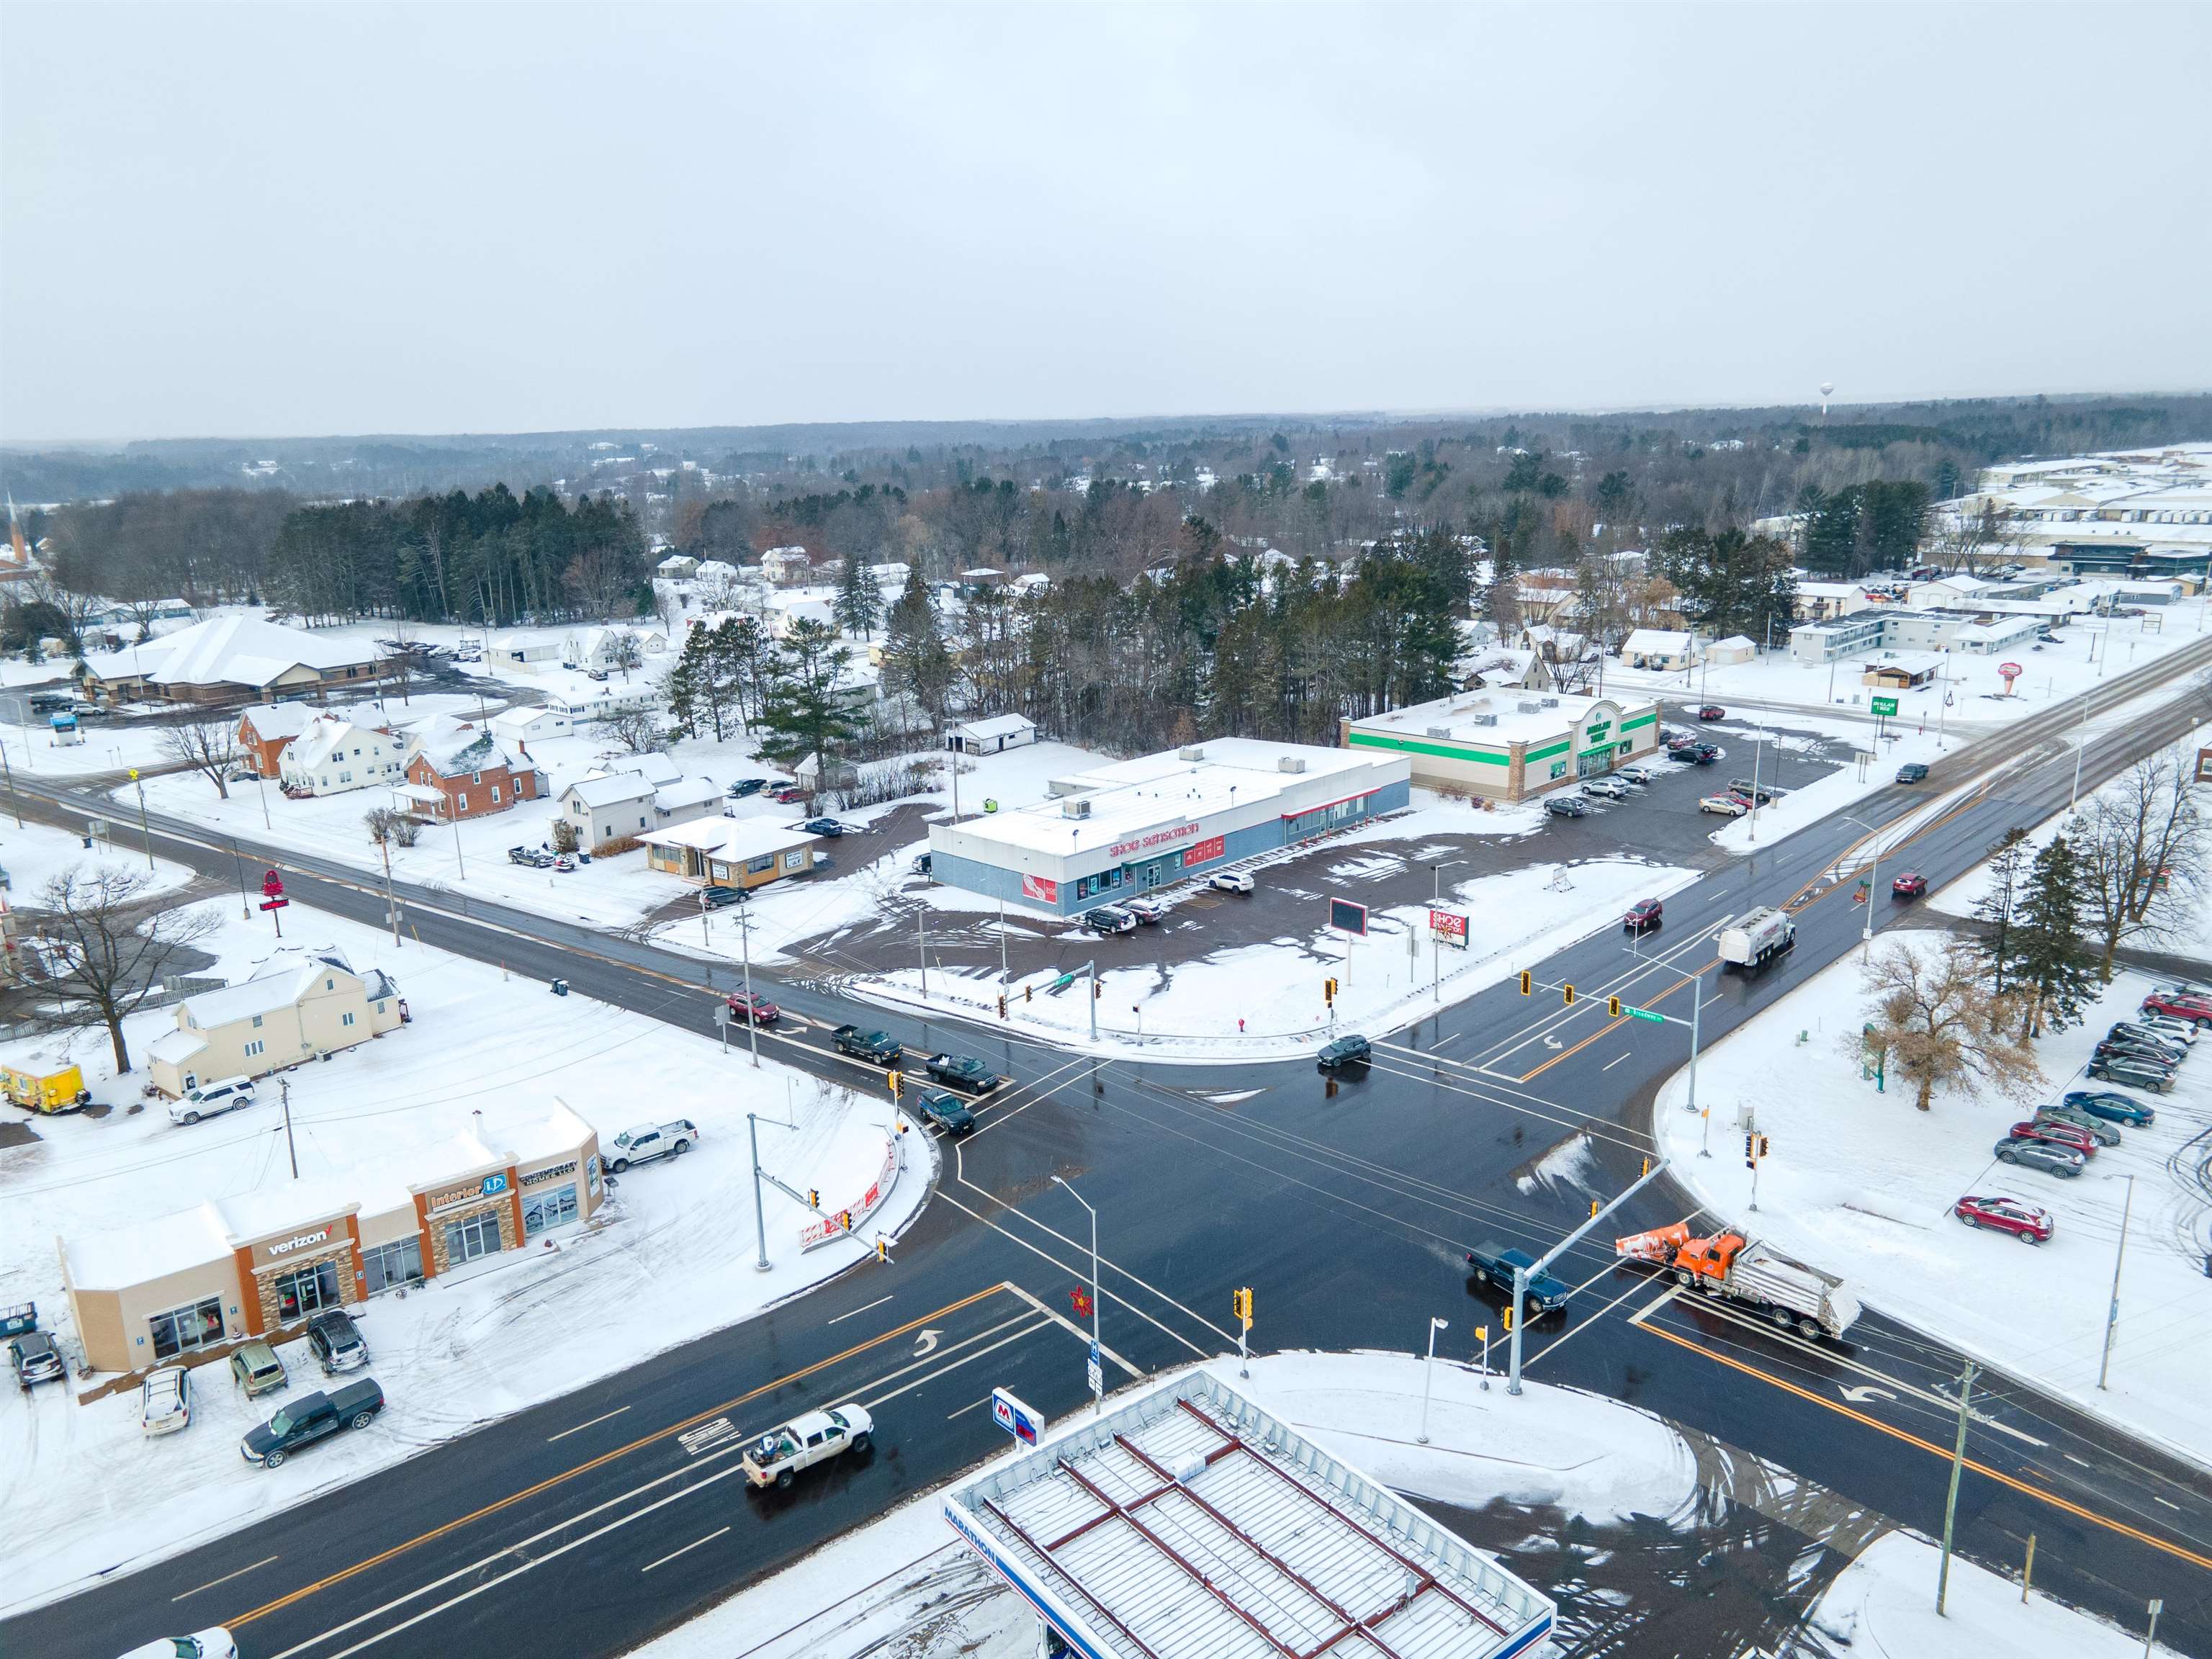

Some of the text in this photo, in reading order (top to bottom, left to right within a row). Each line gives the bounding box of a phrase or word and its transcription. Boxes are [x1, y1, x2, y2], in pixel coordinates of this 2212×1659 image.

[519, 1160, 577, 1182] CONTEMPORARY
[431, 1184, 481, 1208] Interior
[268, 1231, 328, 1256] verizon
[678, 1417, 742, 1455] ONLY
[945, 1506, 996, 1564] MARATHON
